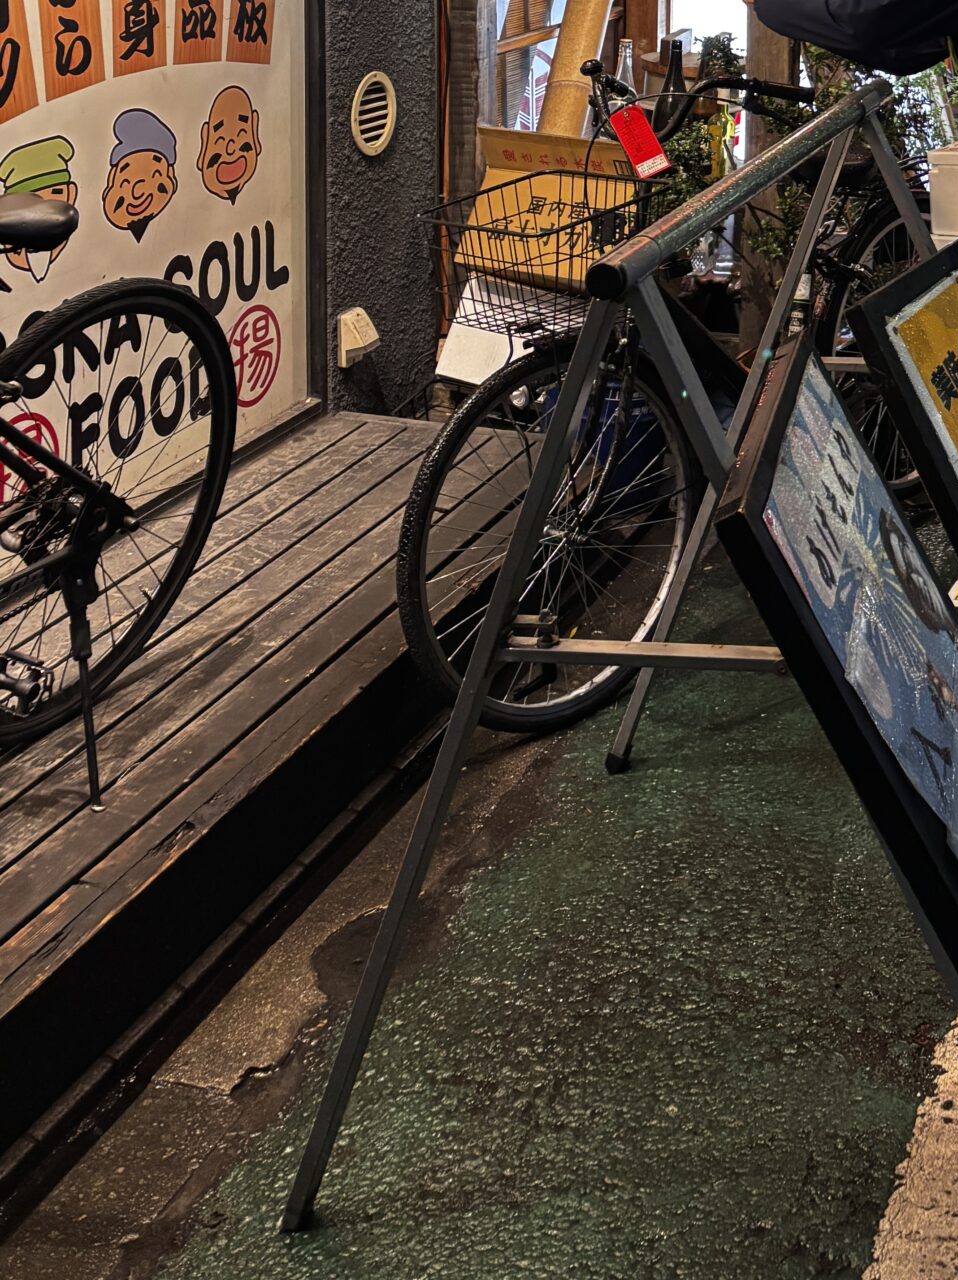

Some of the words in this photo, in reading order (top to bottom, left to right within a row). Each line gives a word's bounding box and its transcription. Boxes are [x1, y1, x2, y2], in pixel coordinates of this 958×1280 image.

[806, 427, 859, 590] あげもんや
